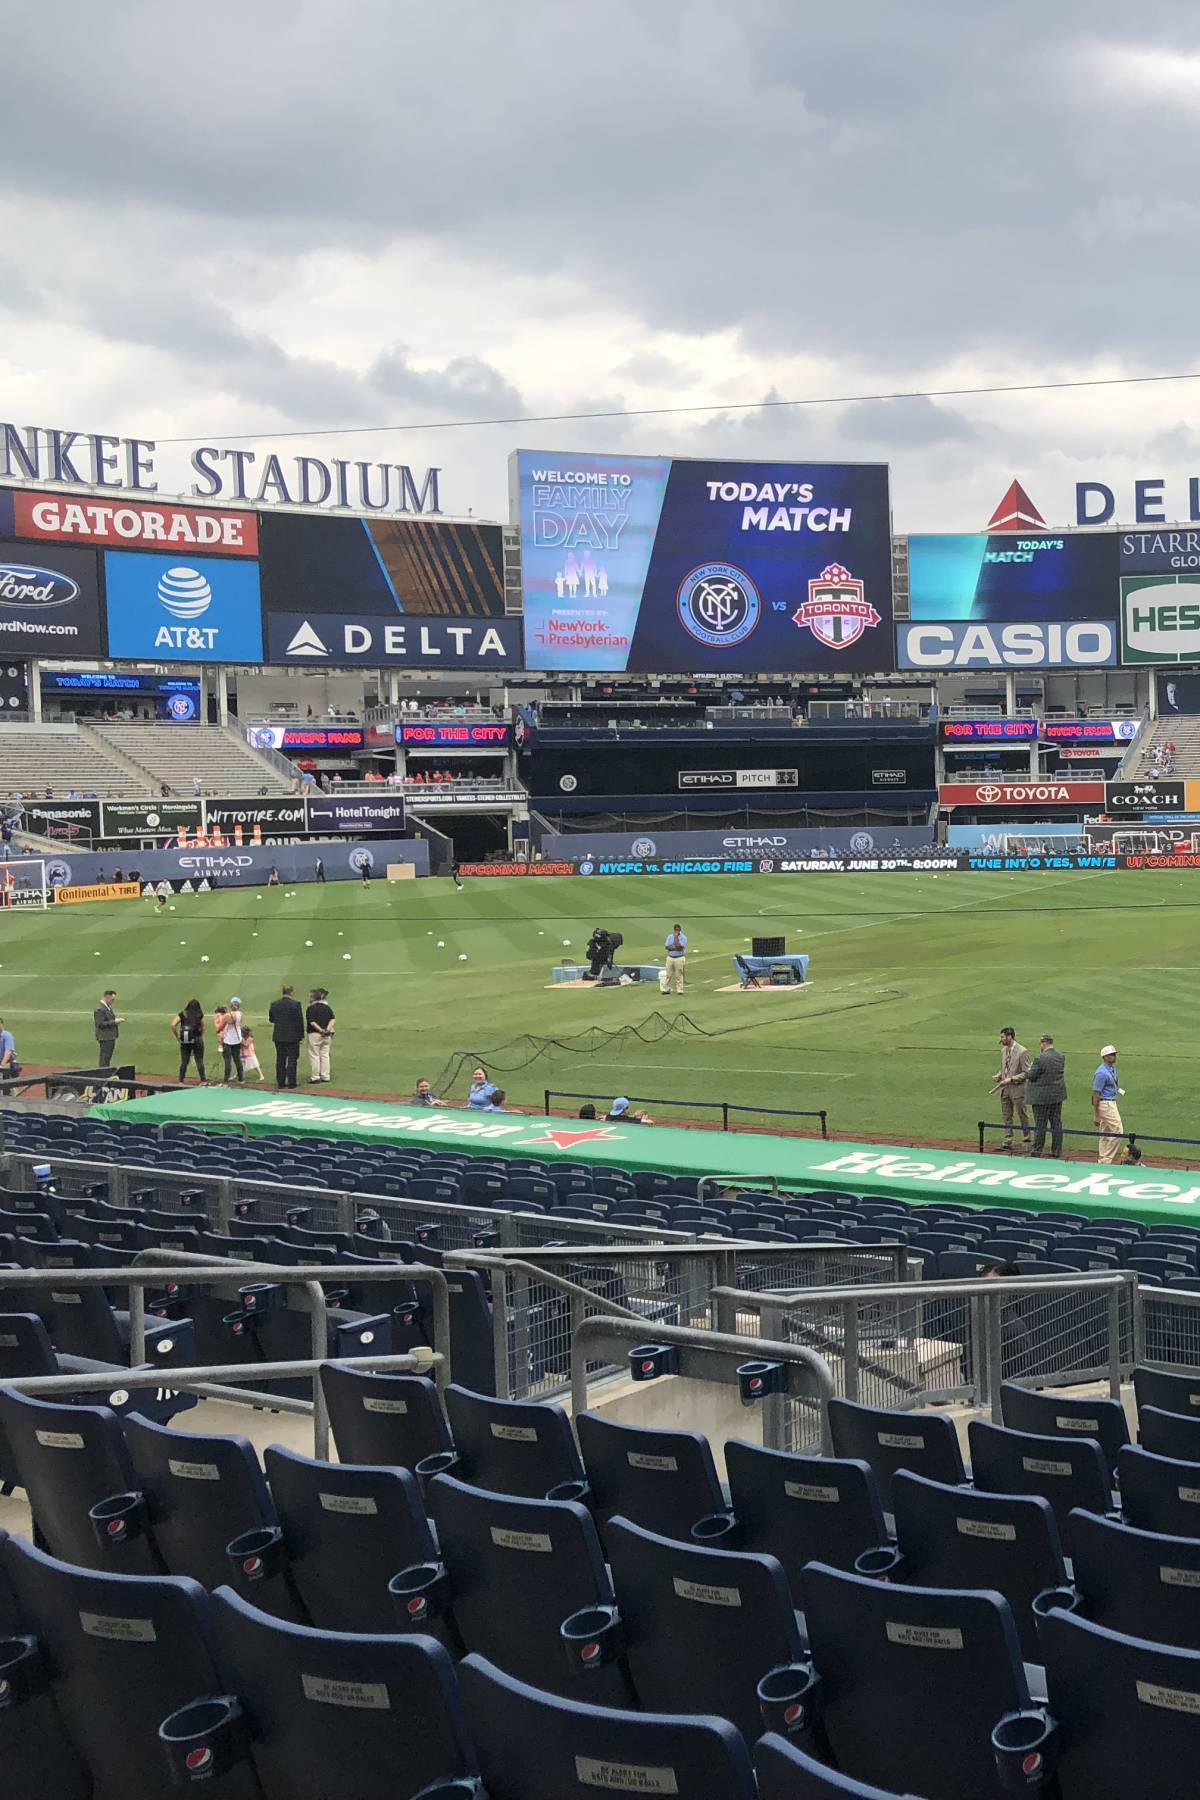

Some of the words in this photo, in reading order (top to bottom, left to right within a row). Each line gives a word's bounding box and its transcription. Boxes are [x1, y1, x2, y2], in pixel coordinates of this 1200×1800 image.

[0, 422, 158, 491] NKEE
[191, 447, 442, 514] STADIUM
[532, 469, 607, 485] WELCOME
[611, 474, 632, 485] TO
[532, 485, 632, 512] FAMILY
[706, 481, 814, 503] TODAY'S
[31, 501, 245, 546] GATORADE
[741, 506, 852, 532] MATCH
[533, 511, 630, 550] DAY
[1017, 540, 1064, 550] TODAY'S
[984, 551, 1034, 563] MATCH
[707, 566, 729, 575] YORK
[772, 601, 788, 611] VS
[806, 603, 868, 616] TORONTO
[548, 620, 610, 633] NewYork-
[154, 626, 219, 649] AT&T
[345, 625, 506, 656] DELTA
[548, 633, 628, 649] Presbyterian
[906, 622, 1113, 666] CASIO
[56, 678, 101, 687] TODAY'S
[104, 678, 139, 688] MATCH
[404, 728, 435, 740] FOR
[438, 728, 468, 740] THE
[471, 727, 506, 740] CITY
[945, 724, 973, 735] FOR
[977, 724, 1002, 735] THE
[1004, 723, 1035, 735] CITY
[682, 774, 733, 784] ETIHAD
[742, 774, 771, 783] PITCH
[873, 771, 904, 779] ETIHAD
[1003, 786, 1070, 801] TOYOTA
[1112, 794, 1178, 805] COACH
[32, 808, 92, 819] Panasonic
[207, 808, 305, 823] NITTOTIRE.COM
[335, 807, 400, 819] HotelTonight
[1083, 814, 1113, 823] FedEx
[723, 837, 787, 847] ETIHAD
[179, 856, 252, 867] ETIHAD
[460, 863, 526, 876] UPCOMING
[528, 863, 574, 875] MATCH
[599, 862, 643, 874] NYCFC
[663, 861, 721, 873] CHICAGO
[723, 860, 753, 872] FIRE
[780, 859, 845, 872] SATURDAY,
[847, 859, 879, 871] JUNE
[969, 858, 1002, 868] TUNE
[1005, 858, 1040, 868] INTO
[1044, 858, 1073, 870] YES,
[194, 869, 241, 877] AIRWAYS
[59, 885, 109, 901] Continental
[119, 886, 138, 895] TIRE
[224, 1100, 522, 1138] Heineken
